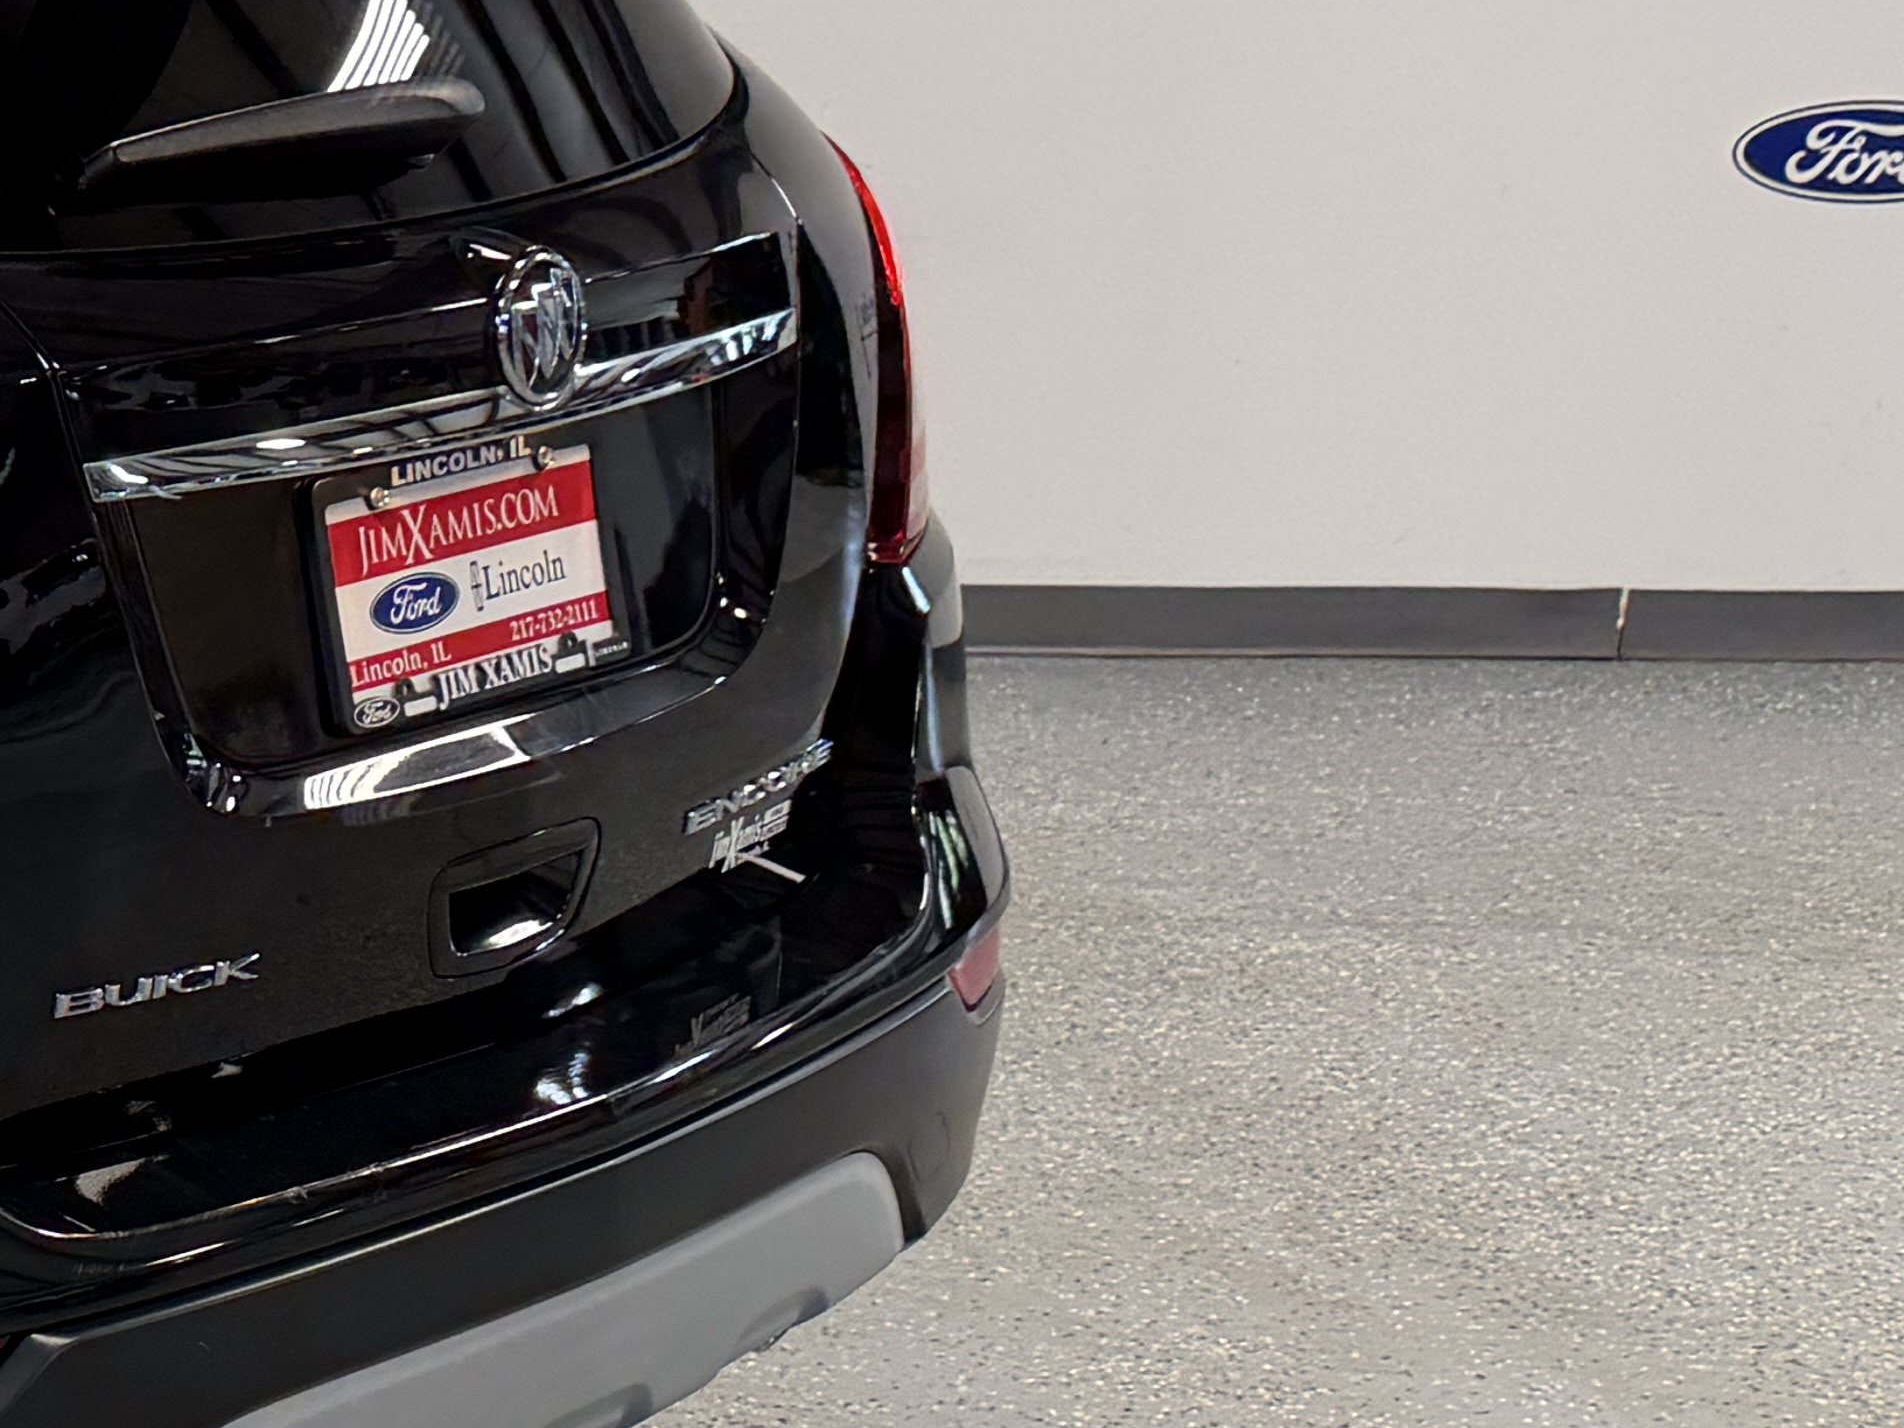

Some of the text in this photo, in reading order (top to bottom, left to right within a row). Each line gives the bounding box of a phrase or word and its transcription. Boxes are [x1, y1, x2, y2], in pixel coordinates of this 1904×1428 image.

[1784, 119, 1904, 185] For
[391, 435, 532, 487] LINCOLN, IL
[358, 485, 559, 576] JIMXAMIS.COM
[481, 550, 567, 602] Lincoln
[390, 582, 441, 625] Ford
[510, 599, 599, 641] 217-732-2111
[350, 641, 452, 687] Lincoln, IL
[438, 645, 553, 711] JIM XAMIS
[53, 953, 260, 1019] BUICK
